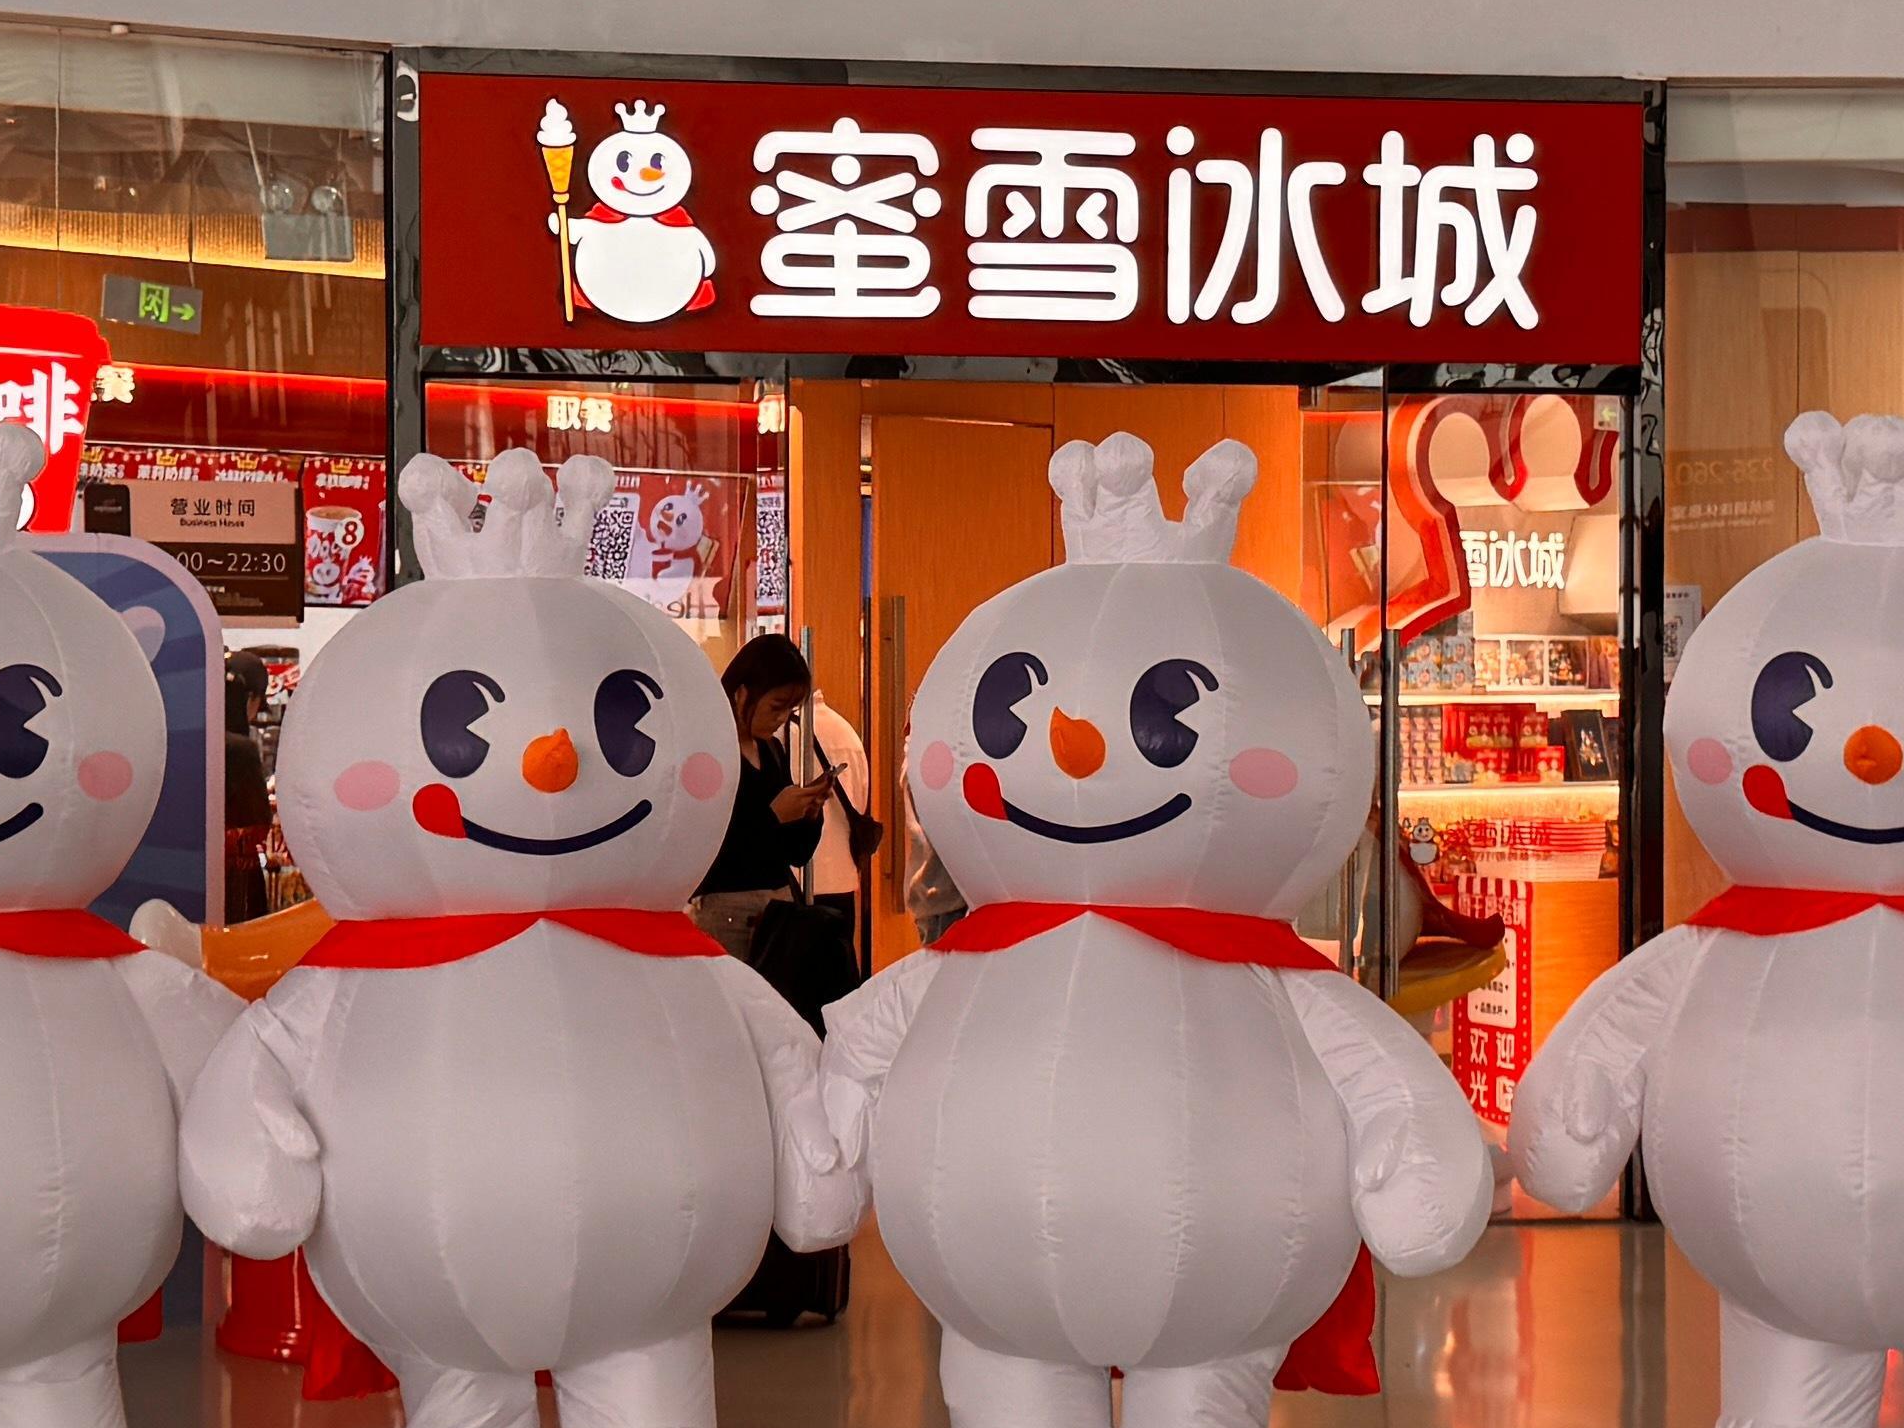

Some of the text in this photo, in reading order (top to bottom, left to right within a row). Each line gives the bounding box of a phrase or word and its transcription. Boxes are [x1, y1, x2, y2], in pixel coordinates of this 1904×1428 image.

[748, 117, 1541, 331] 蜜雪冰城
[171, 498, 255, 517] 营业时间
[342, 521, 358, 546] 8
[1469, 1027, 1516, 1071] 欢迎
